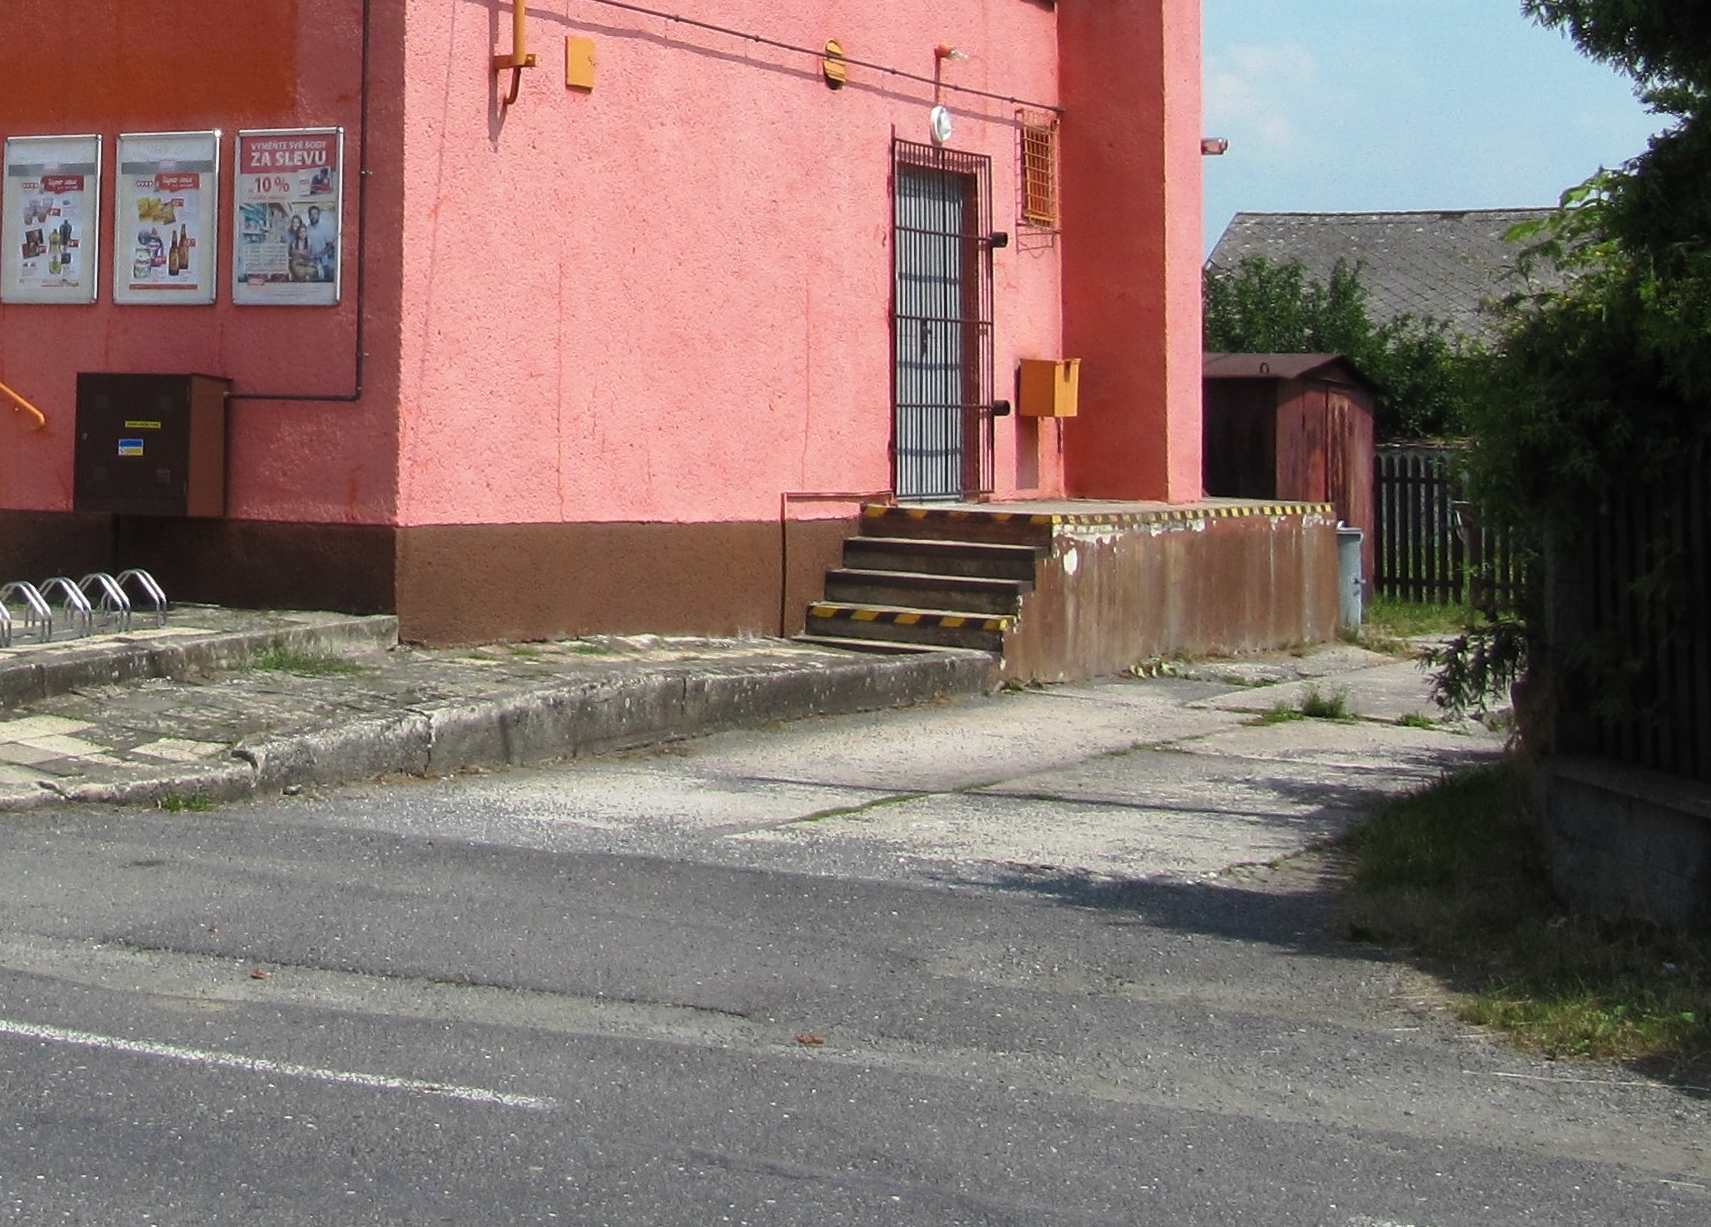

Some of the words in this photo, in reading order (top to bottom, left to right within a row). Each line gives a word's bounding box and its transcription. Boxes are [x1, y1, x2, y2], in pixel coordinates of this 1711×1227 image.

[251, 151, 272, 167] ZA
[275, 150, 327, 166] SLEVU
[255, 176, 271, 193] 10
